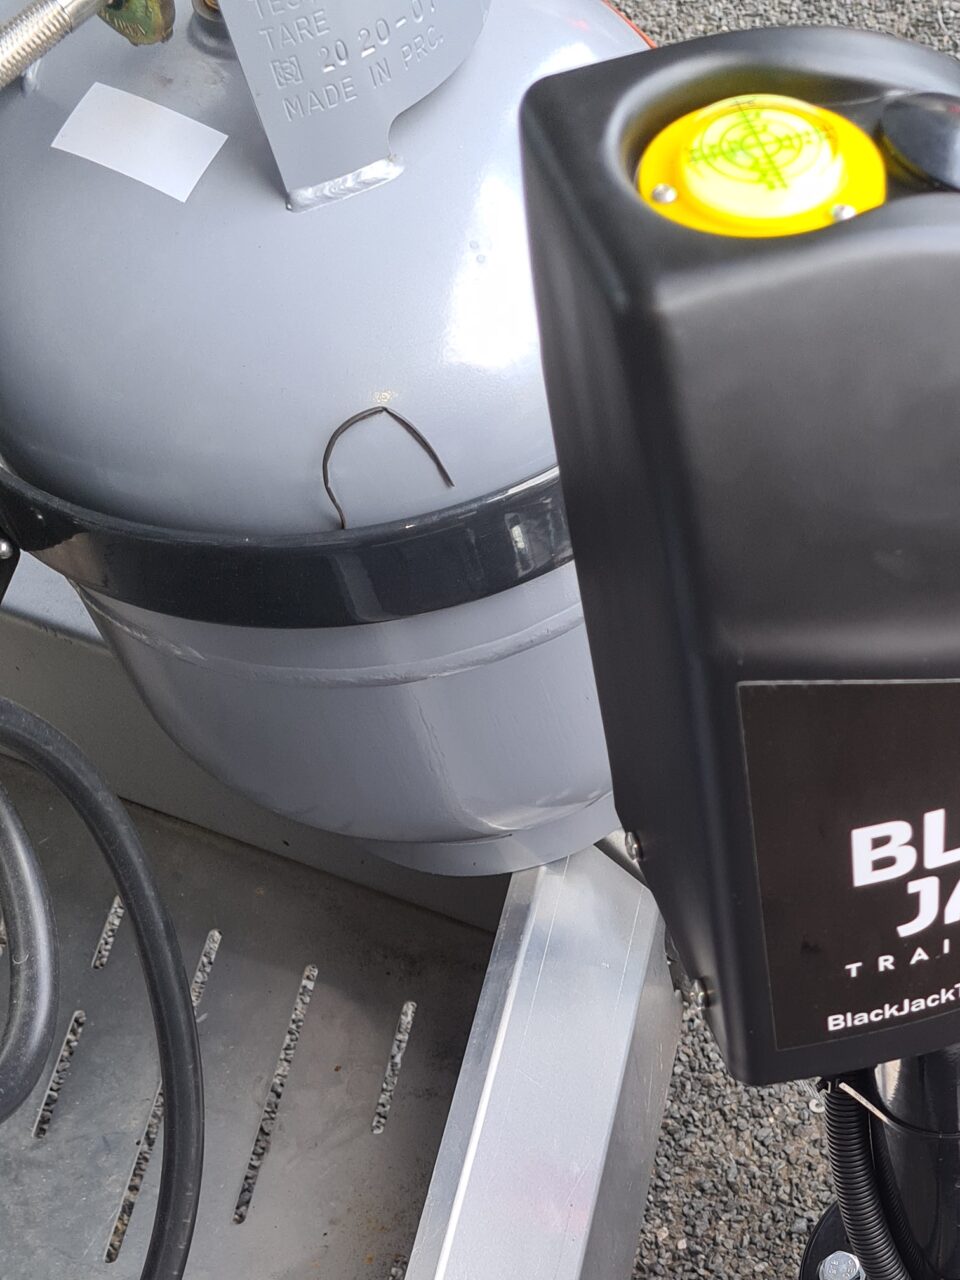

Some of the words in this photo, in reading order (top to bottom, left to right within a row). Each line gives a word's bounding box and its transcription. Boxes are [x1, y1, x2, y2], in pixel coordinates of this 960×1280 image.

[258, 9, 330, 50] TARE
[281, 76, 358, 122] MADE
[368, 57, 392, 89] IN
